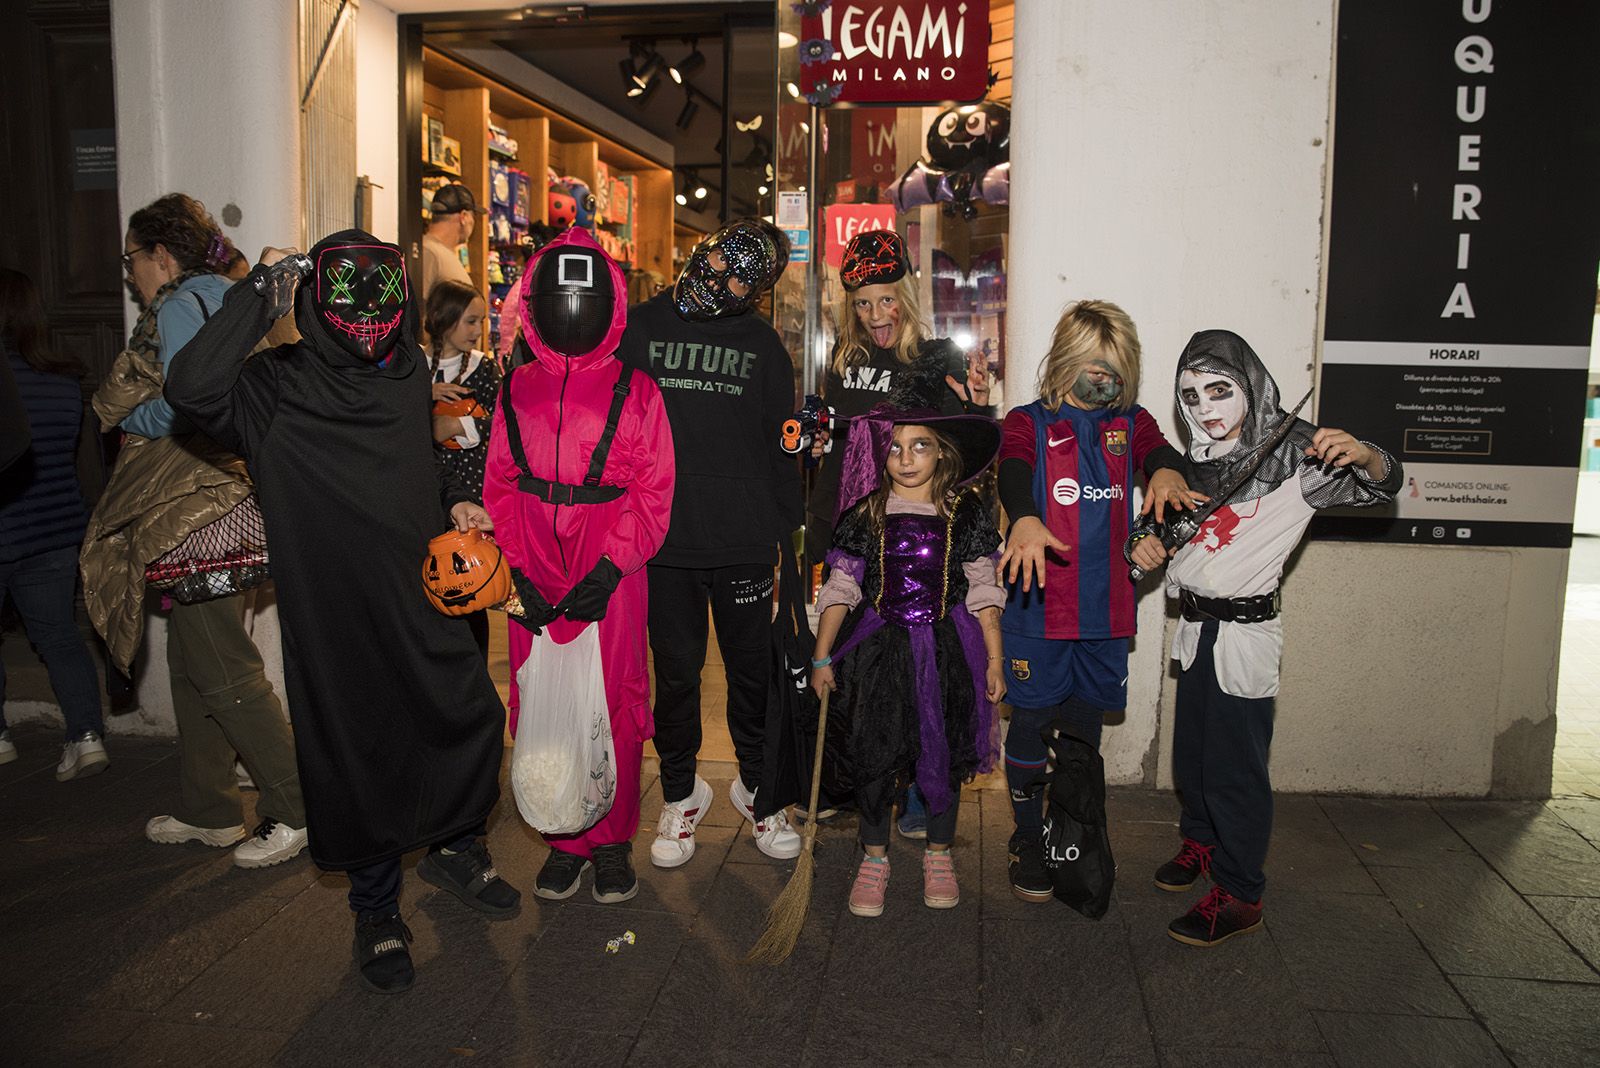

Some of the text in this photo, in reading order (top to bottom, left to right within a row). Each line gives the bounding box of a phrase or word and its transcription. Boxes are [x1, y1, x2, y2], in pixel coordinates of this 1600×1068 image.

[832, 67, 956, 81] MILANO
[649, 340, 757, 379] FUTURE
[1430, 349, 1480, 360] HORARI
[1424, 481, 1474, 490] COMANDES
[735, 595, 758, 604] NEVER
